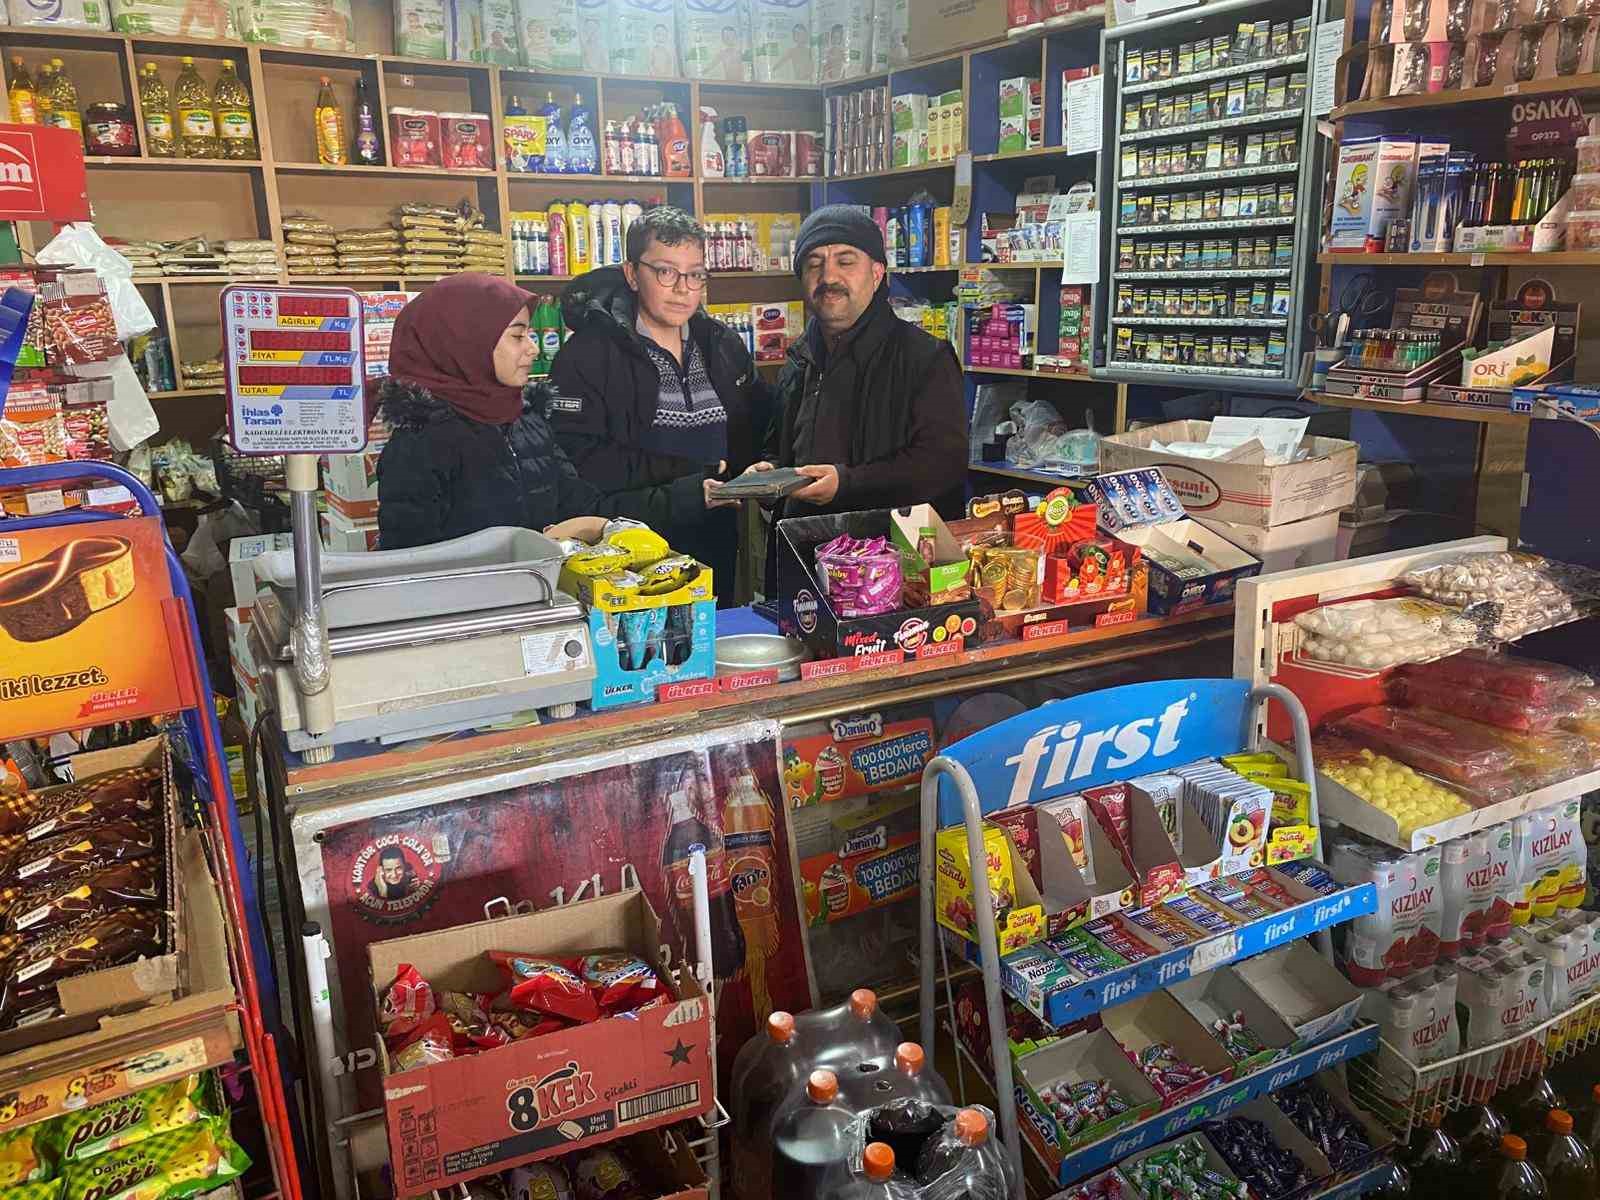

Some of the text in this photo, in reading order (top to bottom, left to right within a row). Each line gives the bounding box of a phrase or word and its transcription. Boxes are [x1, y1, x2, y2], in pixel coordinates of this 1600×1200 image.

[1512, 97, 1579, 123] OSAKA
[573, 137, 591, 145] OXY
[281, 317, 317, 326] AĞIRLIK
[240, 386, 349, 396] TUTAR TL
[1450, 391, 1489, 403] TOKAI
[241, 404, 270, 417] İhlas
[244, 417, 282, 427] Tarsan
[1088, 484, 1107, 512] ONEO
[1109, 476, 1128, 503] ONEO
[844, 633, 879, 647] Mixed
[855, 640, 886, 656] Fruit
[32, 668, 107, 695] lezzet.
[603, 684, 634, 697] ÜLKER
[667, 684, 713, 699] ÜLKER
[731, 675, 772, 690] ÜLKER
[835, 720, 876, 738] Danino
[1005, 698, 1189, 809] first
[869, 754, 922, 781] BEDAVA
[1531, 829, 1573, 858] KIZILAY
[1313, 901, 1344, 926] first
[1263, 915, 1296, 944] first
[1158, 958, 1191, 985] first
[1102, 974, 1137, 1006] first
[1412, 1014, 1450, 1047] KIZILAY
[1316, 1045, 1349, 1072] first
[1268, 1064, 1300, 1091] first
[65, 1101, 144, 1160] pöti
[589, 1123, 609, 1134] Pack
[590, 1114, 606, 1125] Unit
[1110, 1130, 1147, 1159] first
[93, 1151, 146, 1177] Dankek
